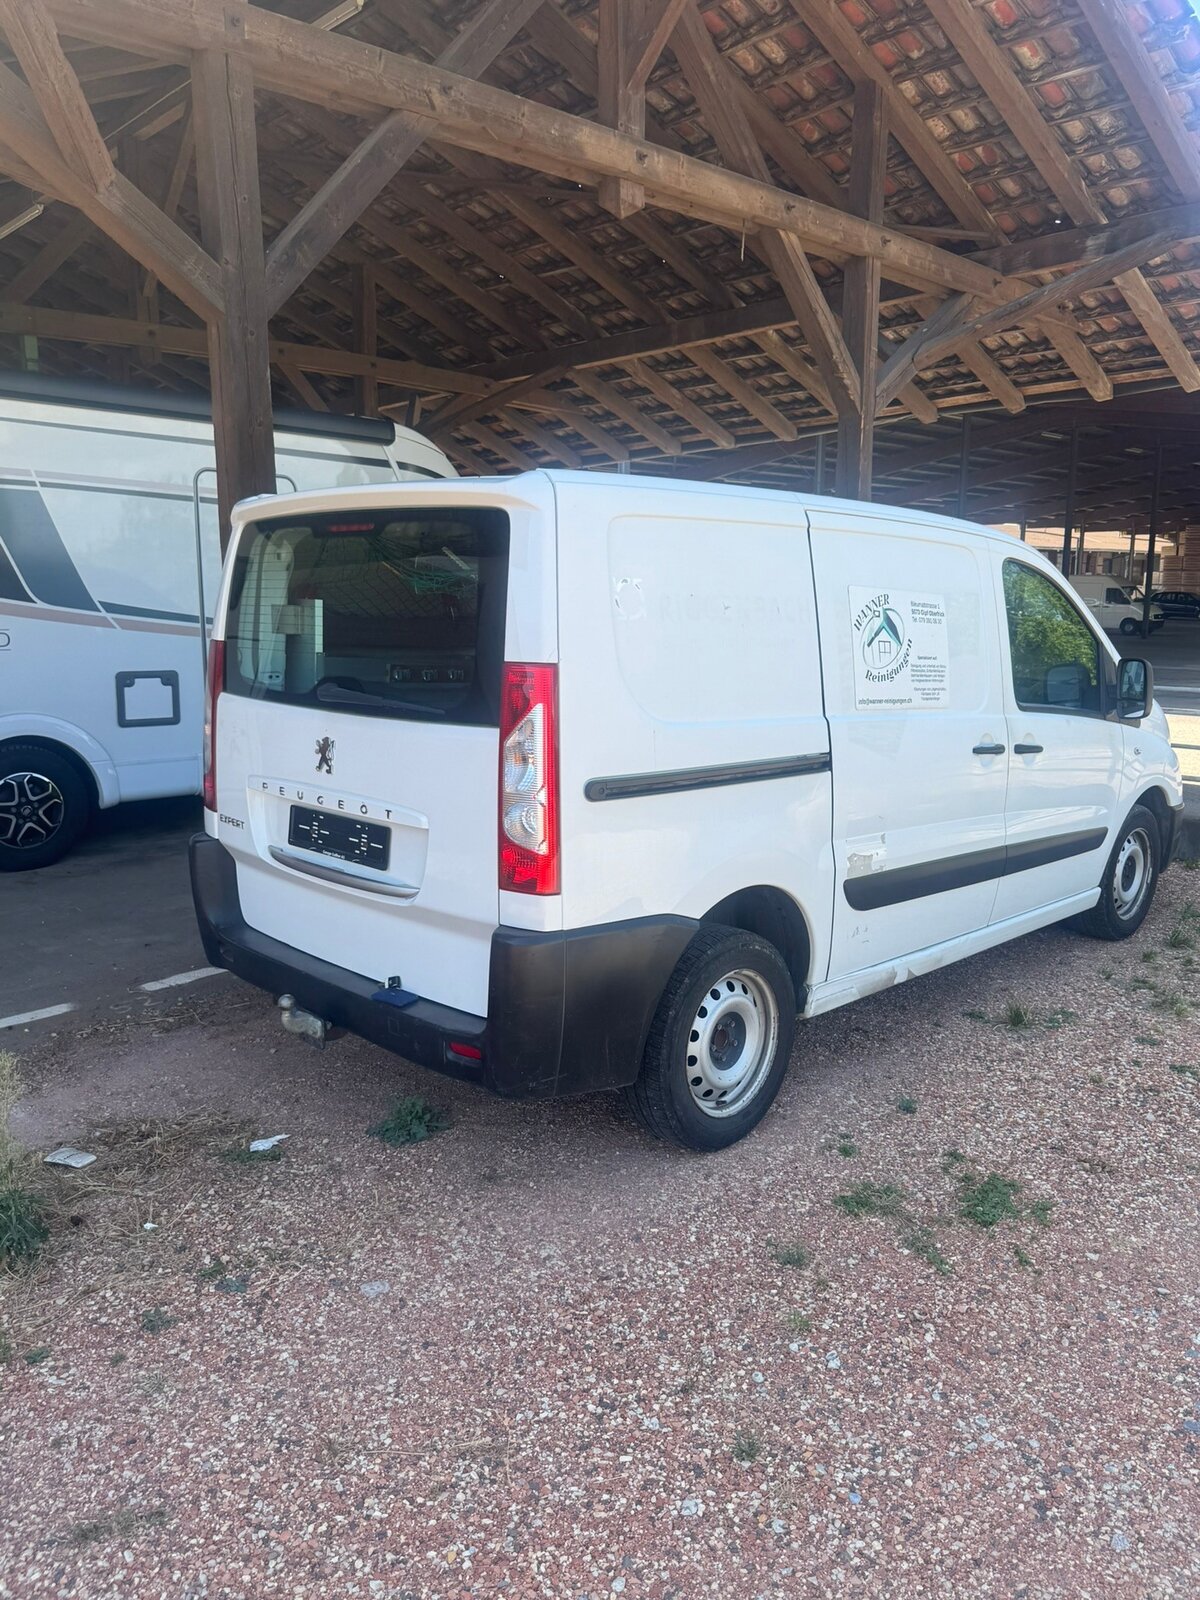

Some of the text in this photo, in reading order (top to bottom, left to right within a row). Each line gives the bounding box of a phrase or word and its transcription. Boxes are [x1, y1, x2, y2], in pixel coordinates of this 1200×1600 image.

[865, 638, 913, 684] Reinigungen
[262, 782, 392, 819] PEUGEOT
[220, 814, 245, 829] EXPERT
